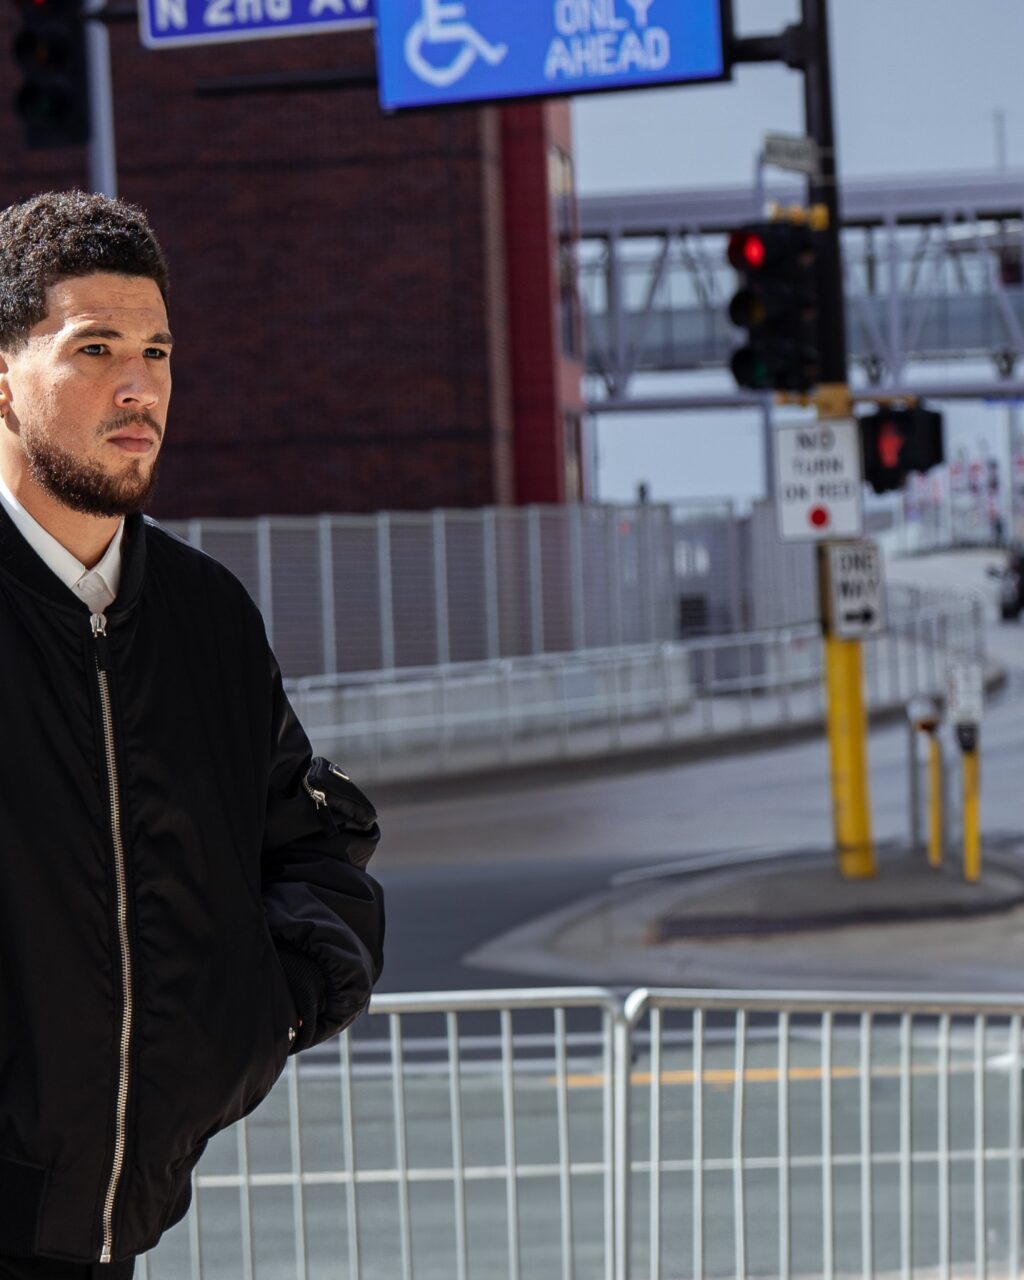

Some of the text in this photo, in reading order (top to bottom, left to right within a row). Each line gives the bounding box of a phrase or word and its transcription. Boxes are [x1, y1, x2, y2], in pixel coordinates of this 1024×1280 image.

[155, 0, 188, 31] N
[553, 0, 655, 35] ONLY
[543, 26, 671, 80] AHEAD
[796, 431, 836, 452] NO
[792, 456, 844, 476] TURN
[785, 482, 851, 501] ON RED
[840, 553, 873, 571] ONE
